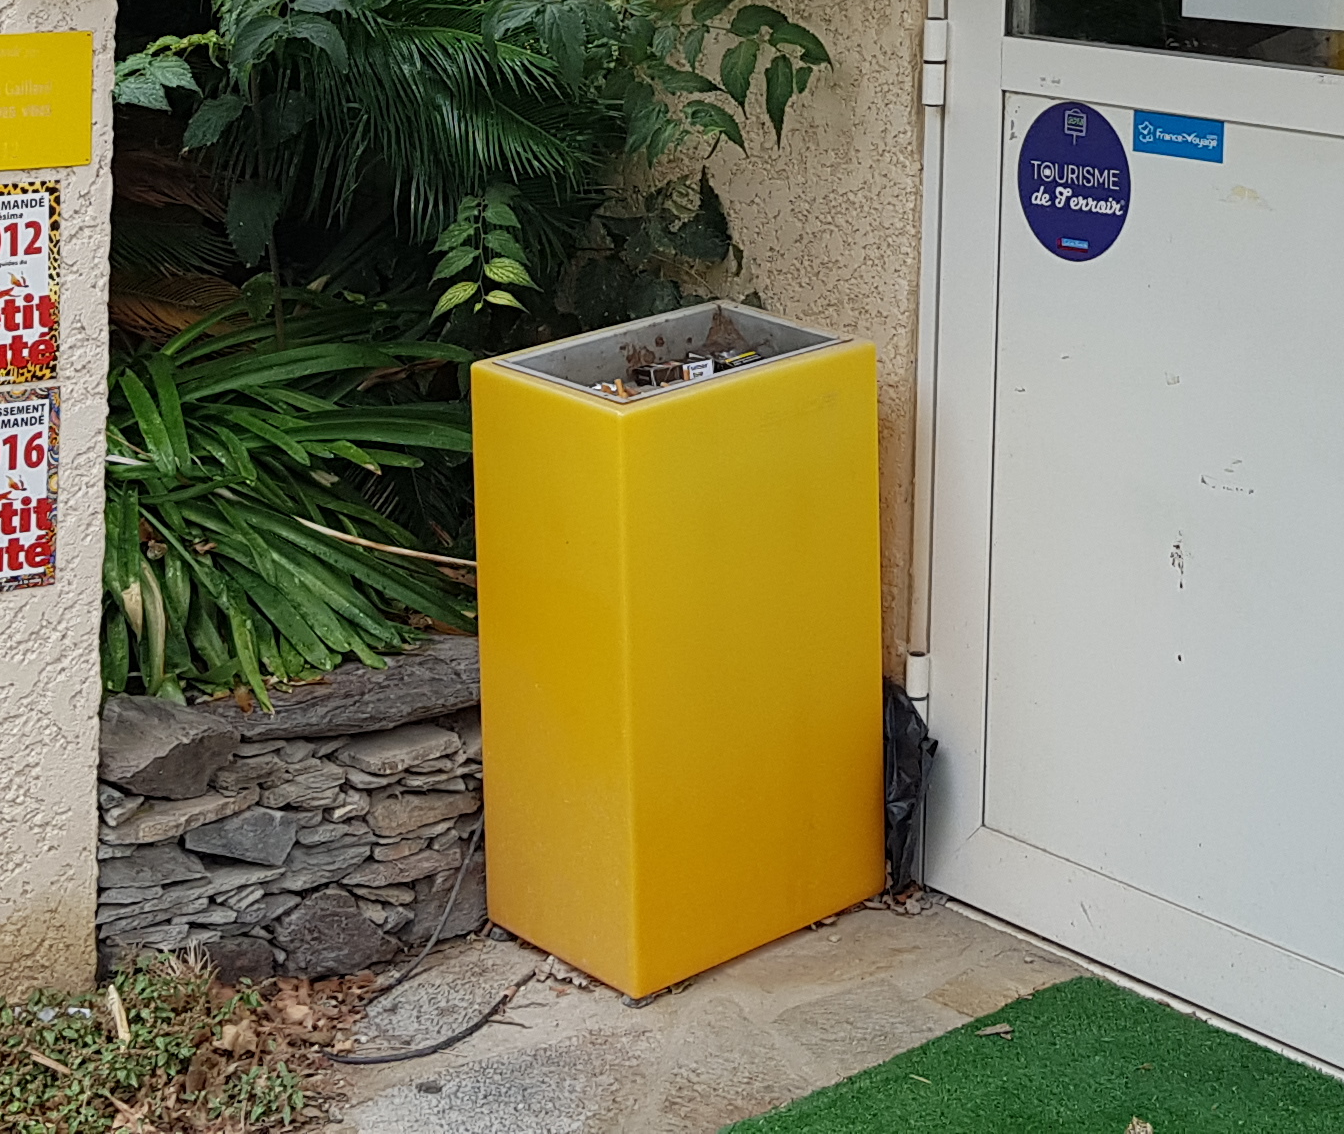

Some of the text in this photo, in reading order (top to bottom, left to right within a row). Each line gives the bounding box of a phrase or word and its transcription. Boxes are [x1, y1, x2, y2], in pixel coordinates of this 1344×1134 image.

[1030, 160, 1120, 190] TOURISME
[1031, 186, 1123, 216] de Terroir
